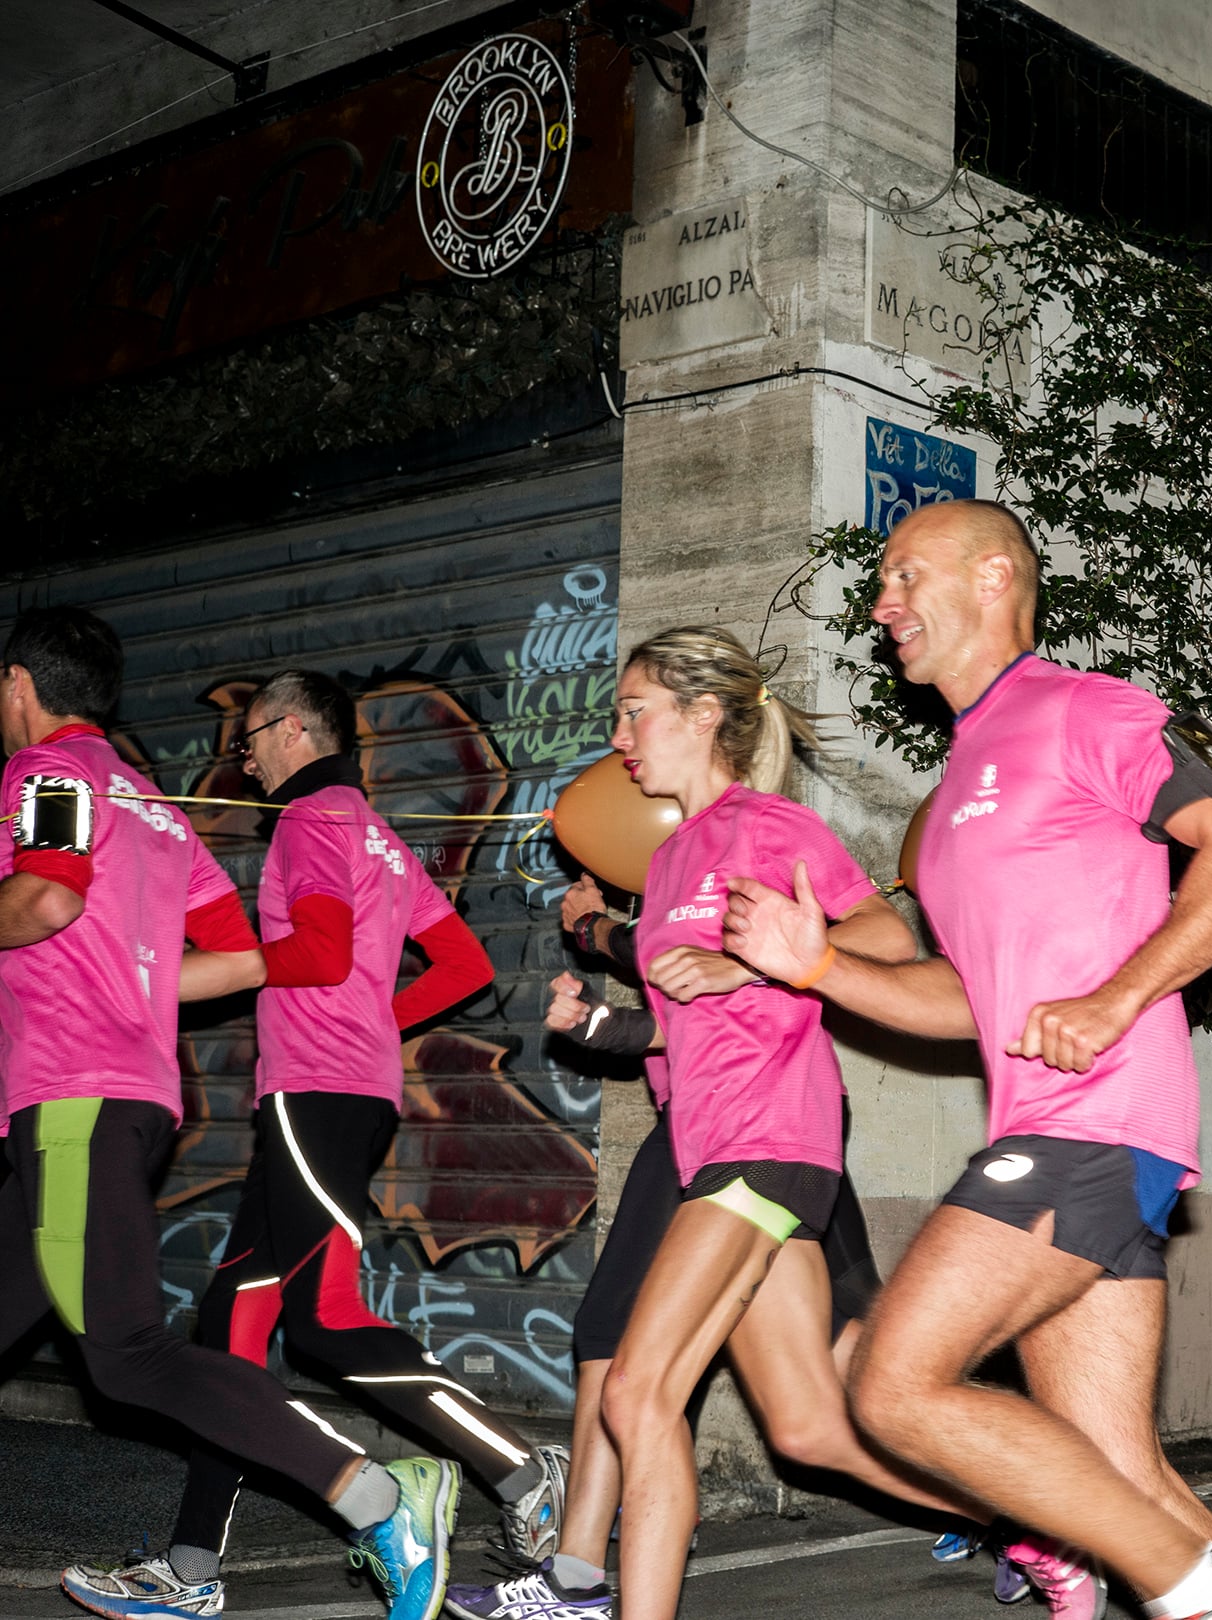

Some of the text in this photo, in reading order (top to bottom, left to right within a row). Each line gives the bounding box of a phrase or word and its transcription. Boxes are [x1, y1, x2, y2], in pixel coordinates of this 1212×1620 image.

[436, 41, 558, 127] BROOKLYN
[432, 188, 547, 270] BREWERY
[624, 275, 722, 322] NAVIGLIO
